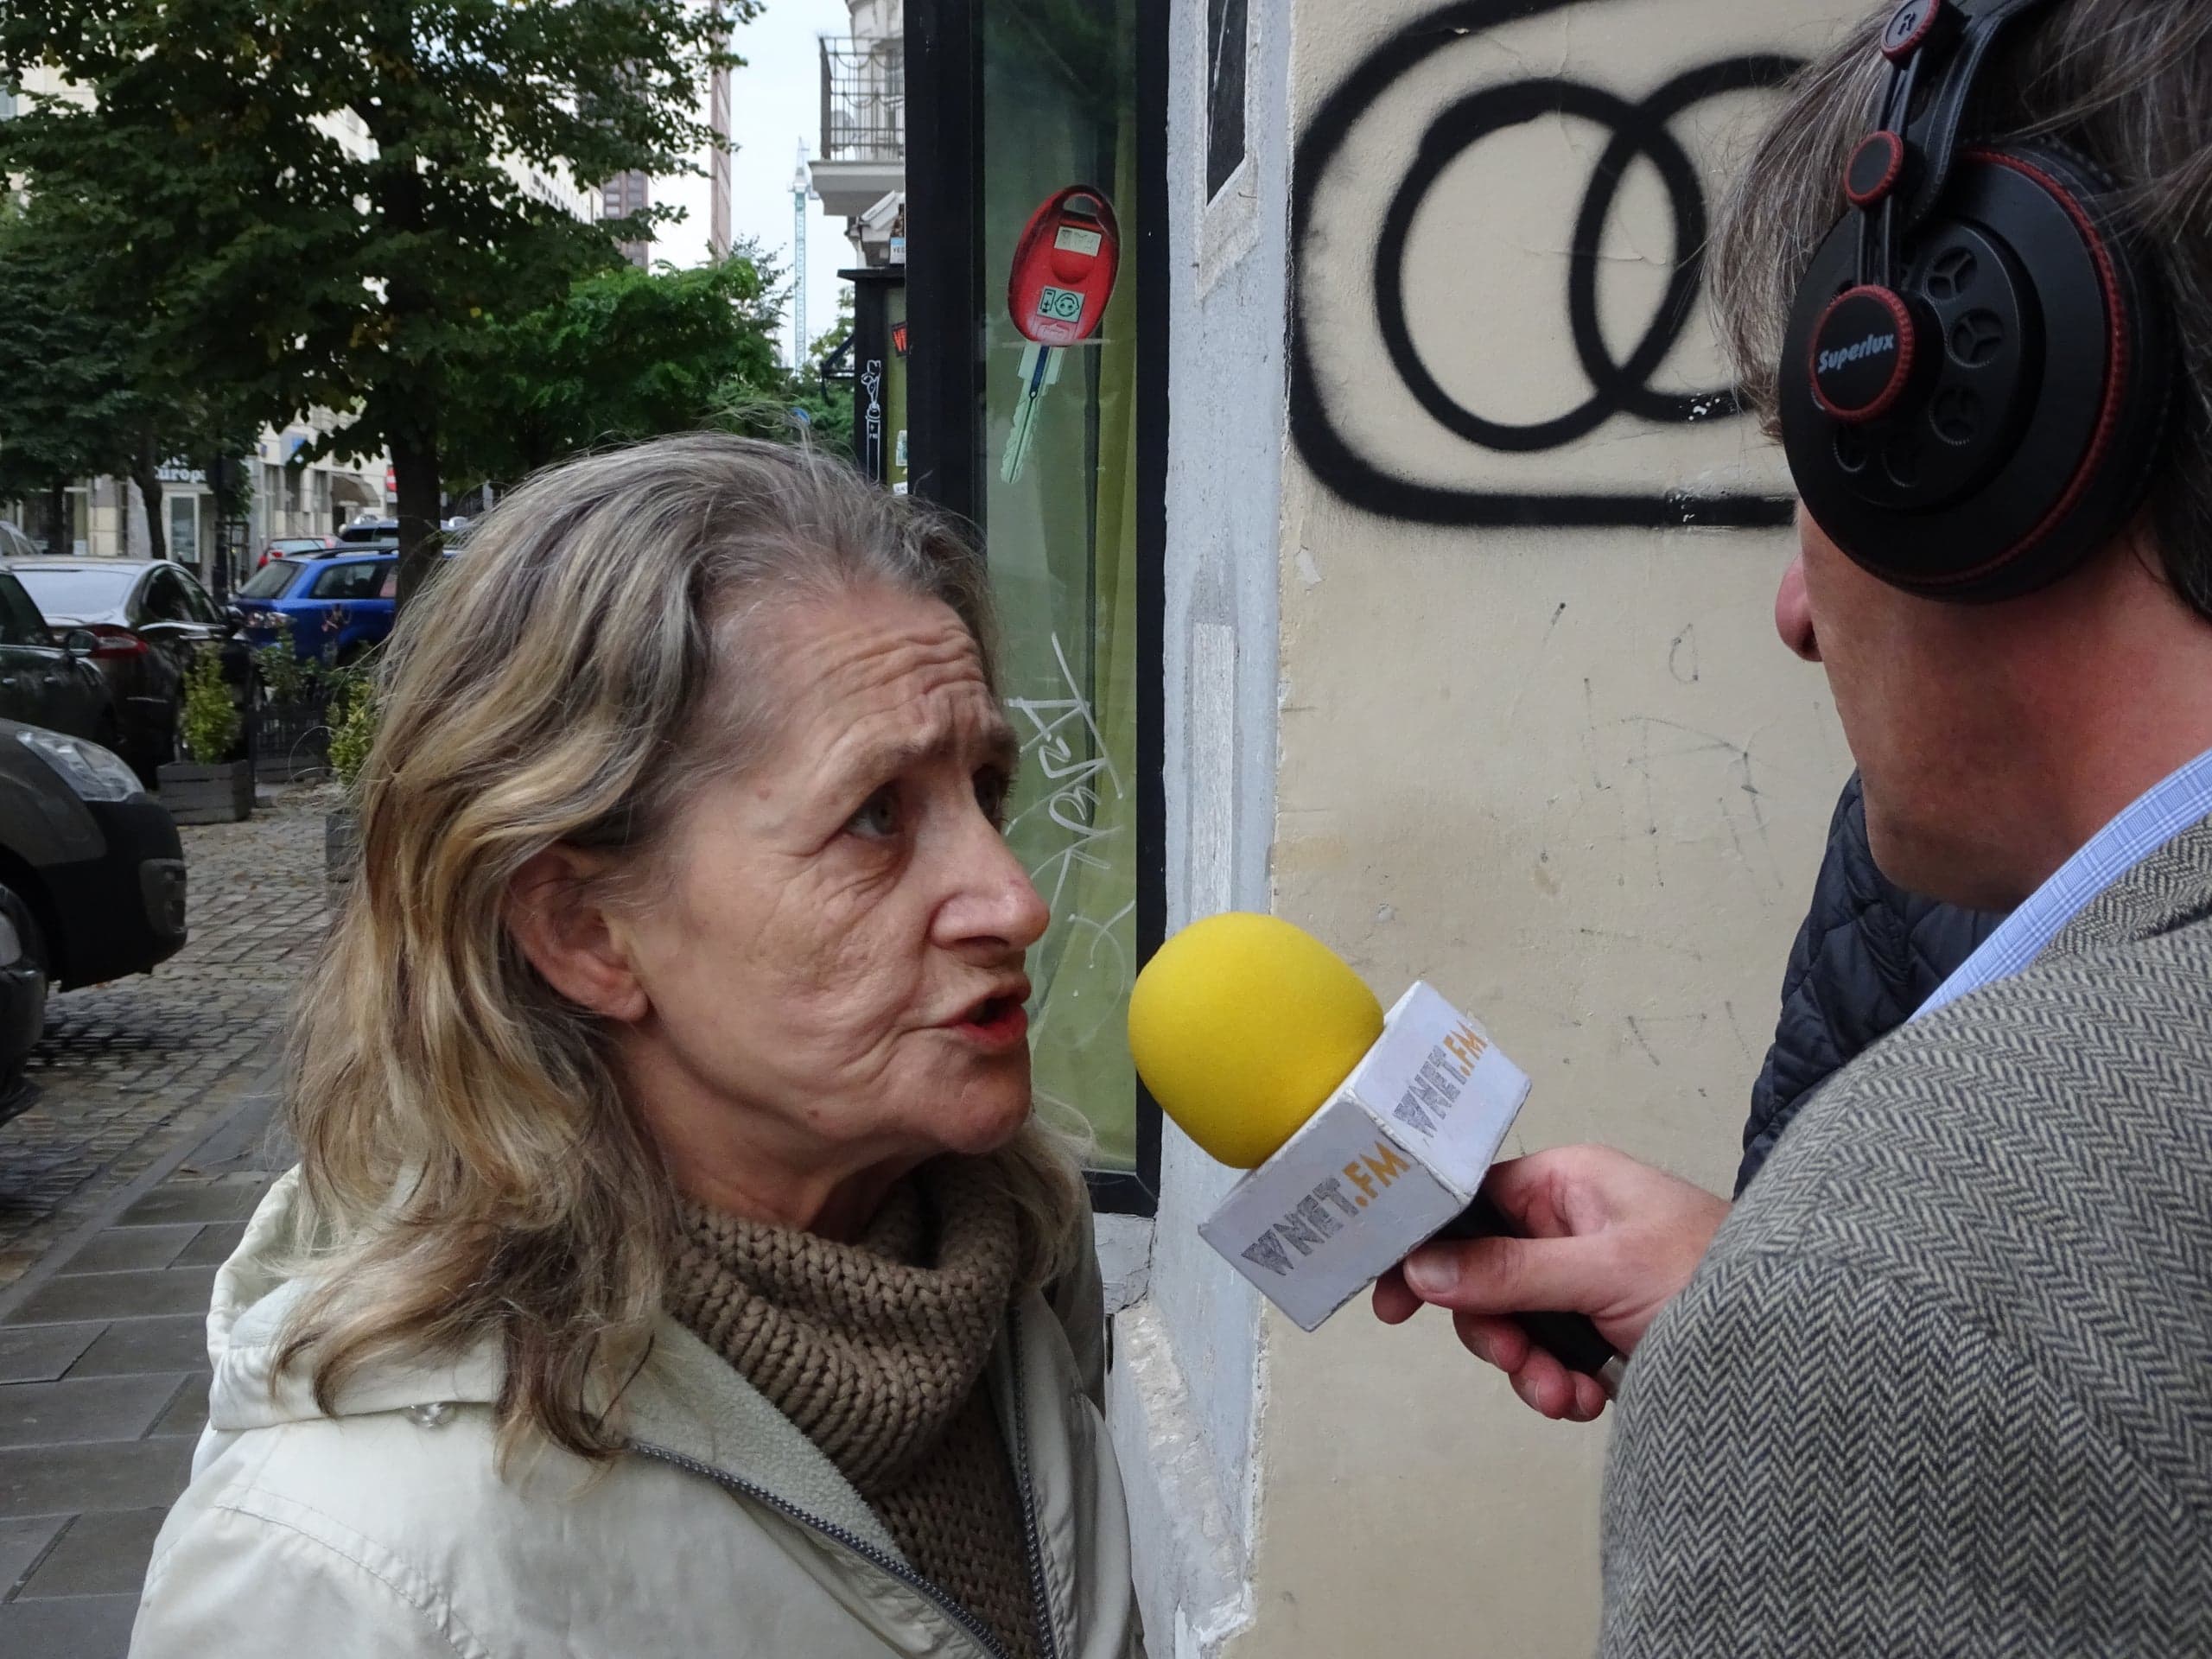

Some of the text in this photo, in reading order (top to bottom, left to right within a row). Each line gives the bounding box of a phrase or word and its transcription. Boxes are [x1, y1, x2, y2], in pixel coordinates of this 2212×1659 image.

[1817, 334, 1895, 373] Superlux
[1391, 1021, 1487, 1138] WNET.FM
[1241, 1141, 1411, 1276] WNET.FM
